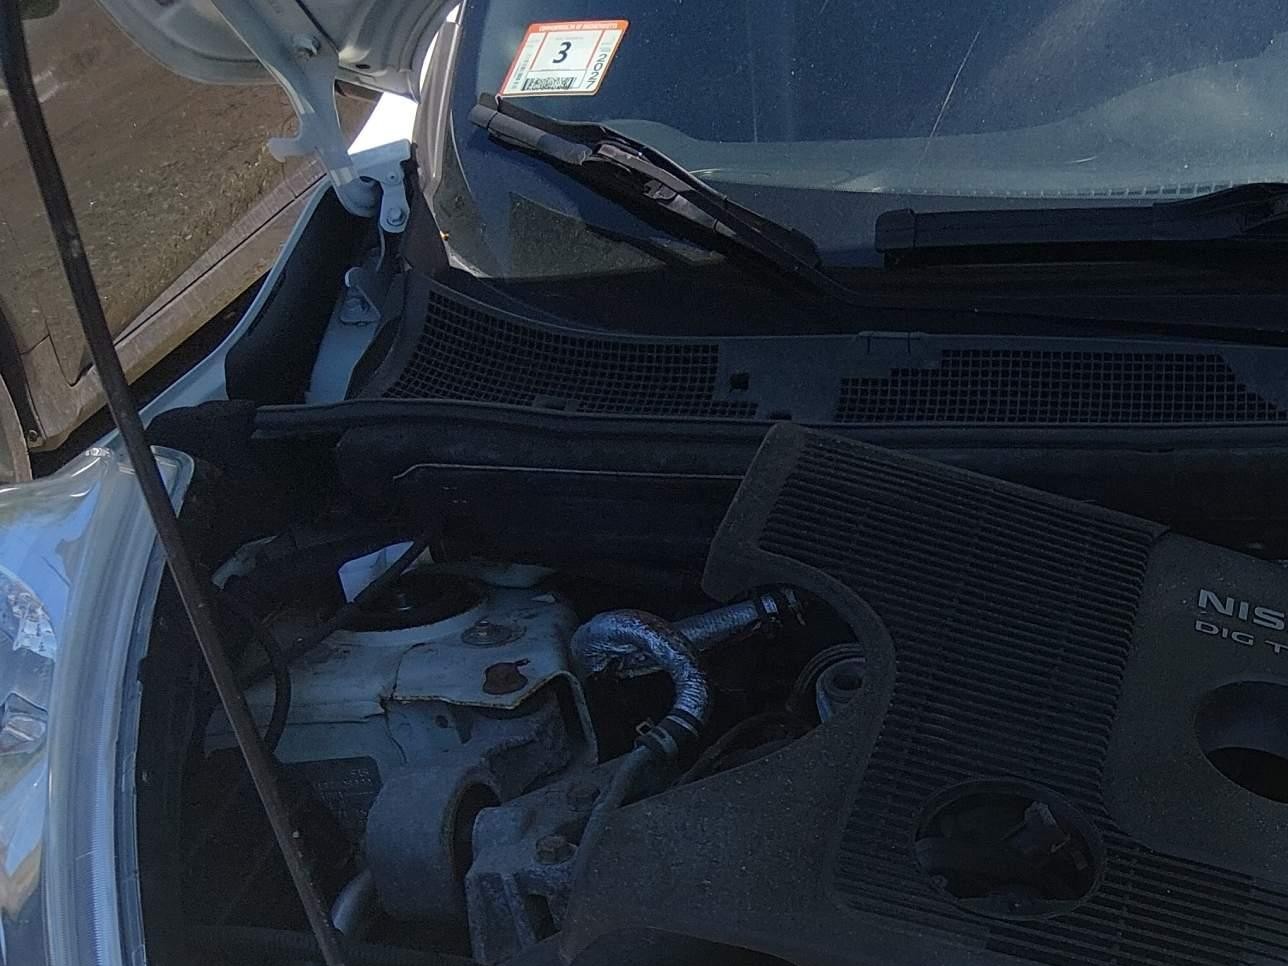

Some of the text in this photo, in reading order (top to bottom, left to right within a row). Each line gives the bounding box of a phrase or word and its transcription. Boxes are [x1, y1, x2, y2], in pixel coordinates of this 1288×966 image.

[552, 41, 572, 63] 3
[584, 54, 608, 89] 2027
[1195, 620, 1255, 646] DIG
